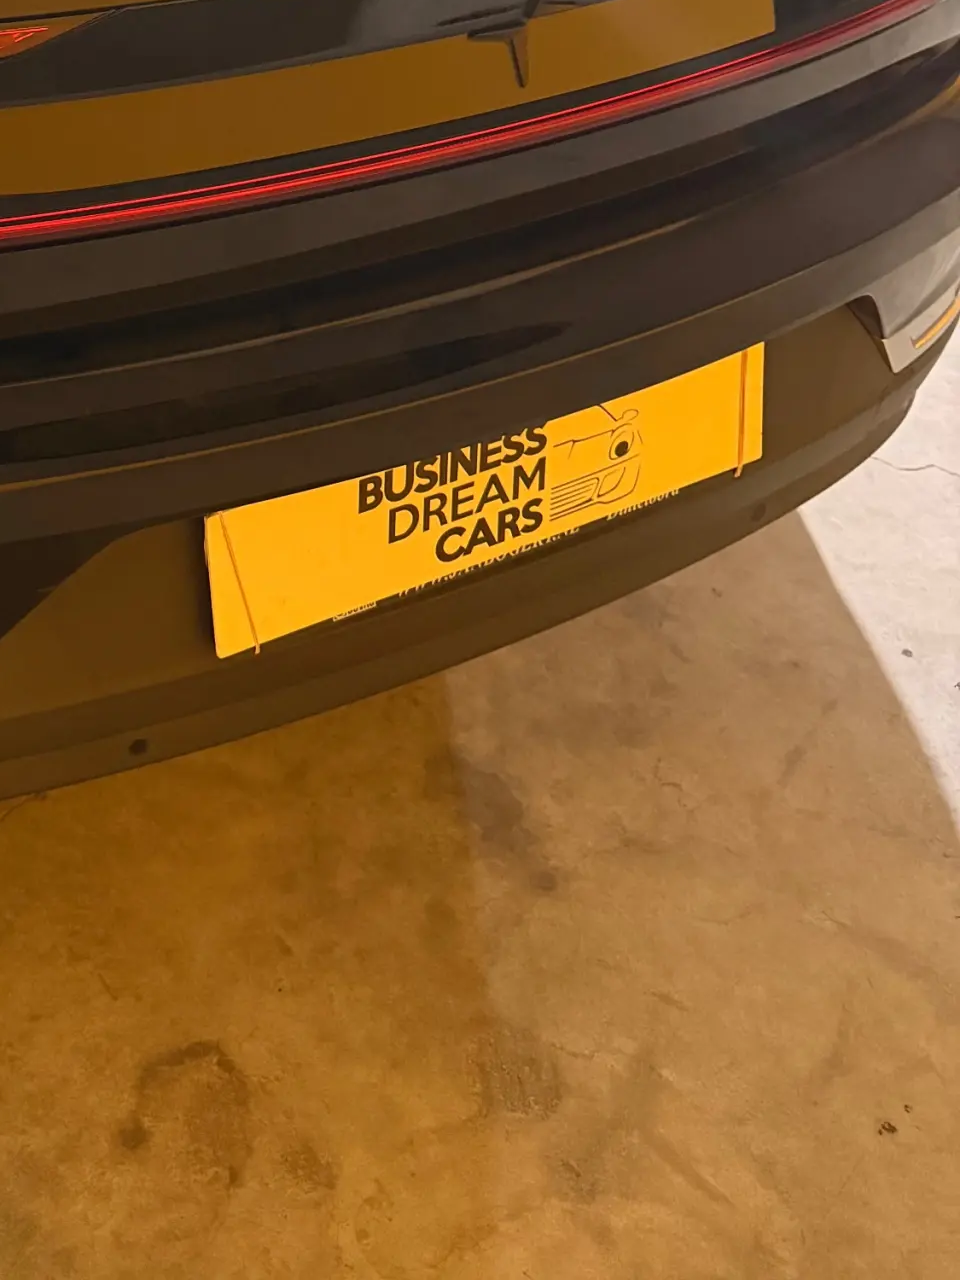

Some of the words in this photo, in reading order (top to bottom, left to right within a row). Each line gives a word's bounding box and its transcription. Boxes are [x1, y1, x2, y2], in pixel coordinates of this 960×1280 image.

[358, 428, 548, 514] BUSINESS
[388, 456, 547, 544] DREAM
[435, 498, 544, 563] CARS
